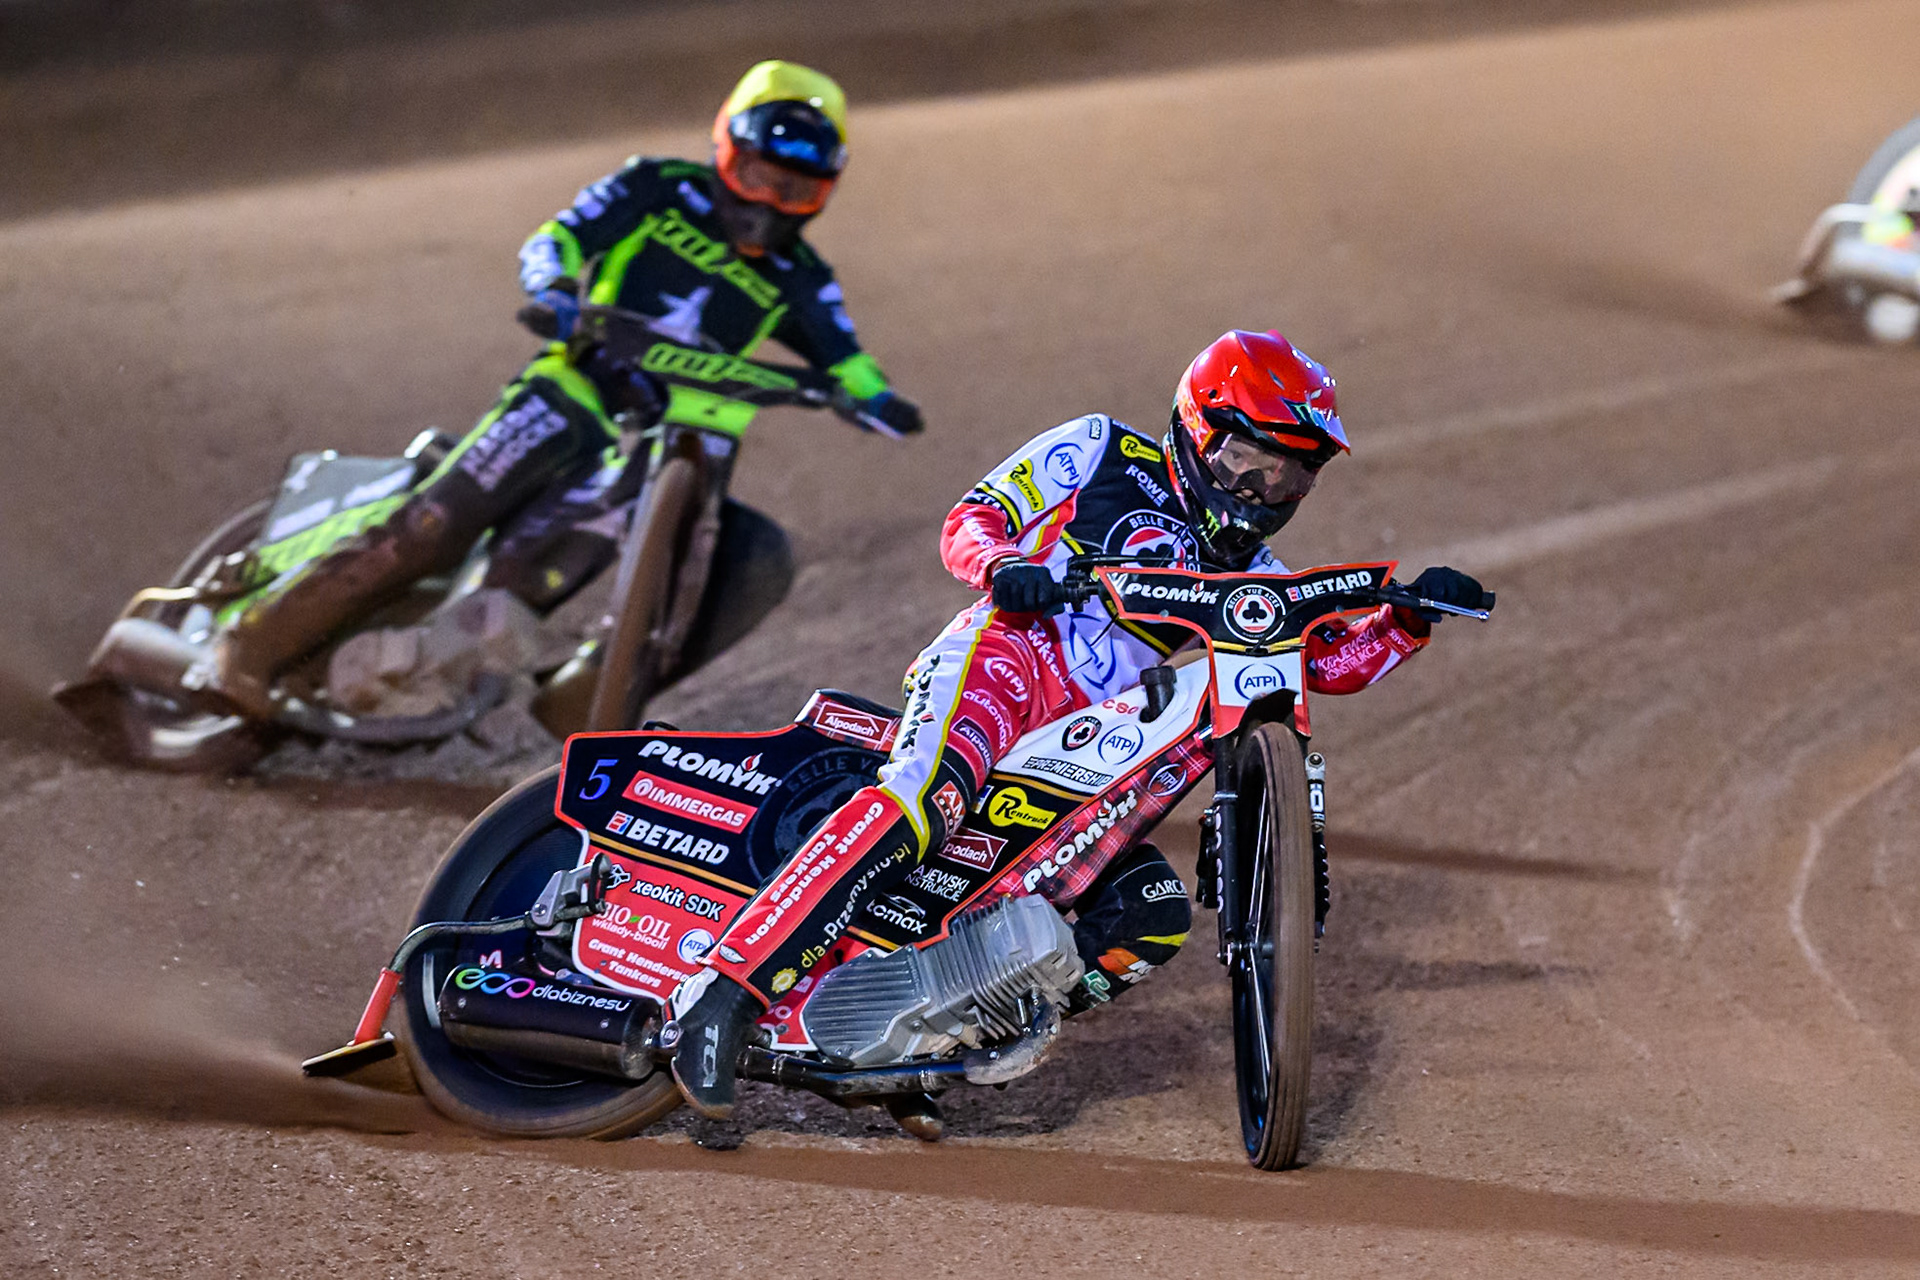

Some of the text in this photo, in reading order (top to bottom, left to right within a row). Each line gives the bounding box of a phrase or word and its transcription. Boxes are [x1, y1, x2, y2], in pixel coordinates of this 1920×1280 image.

[1054, 452, 1080, 482] ATPI
[1125, 464, 1170, 504] ROWE
[1128, 515, 1164, 529] BELLE
[1227, 590, 1245, 609] BELLE
[1264, 592, 1280, 608] ACES
[1300, 570, 1372, 599] BETARD
[1243, 674, 1277, 691] ATPI
[824, 715, 875, 737] Alpodach
[962, 690, 1008, 750] automax
[1104, 735, 1136, 753] ATPI
[578, 759, 619, 800] 5
[1157, 771, 1178, 788] ATPI
[648, 788, 747, 827] IMMERGAS
[993, 793, 1049, 825] Rentruck
[626, 818, 730, 866] BETARD
[942, 843, 988, 863] podach
[744, 801, 885, 945] Grant Henderson
[769, 833, 838, 903] Tankers
[912, 864, 971, 892] AJEWSKI
[632, 880, 726, 922] xeokit SDK
[904, 873, 962, 903] NSTRUKCJE
[596, 901, 672, 942] BIO OIL
[865, 899, 928, 935] tomax
[588, 938, 692, 983] Grant Henderso
[608, 960, 662, 988] Tankers
